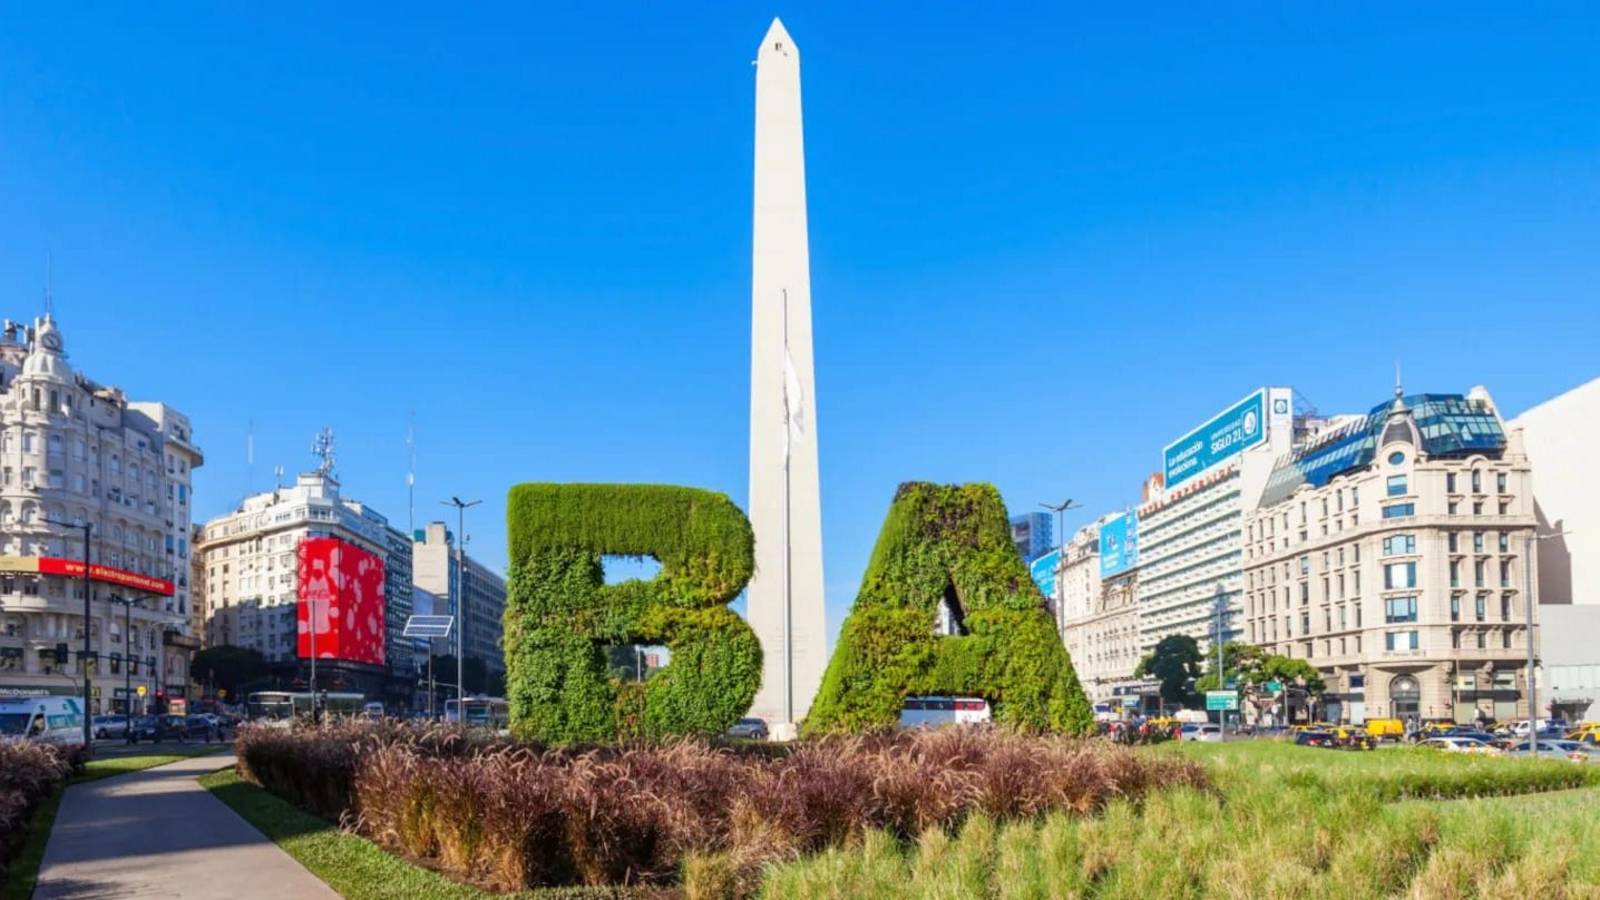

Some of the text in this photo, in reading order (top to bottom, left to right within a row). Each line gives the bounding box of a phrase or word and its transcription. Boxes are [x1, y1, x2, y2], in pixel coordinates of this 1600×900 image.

[1176, 441, 1203, 462] educación
[1211, 428, 1242, 454] SIGLO 21
